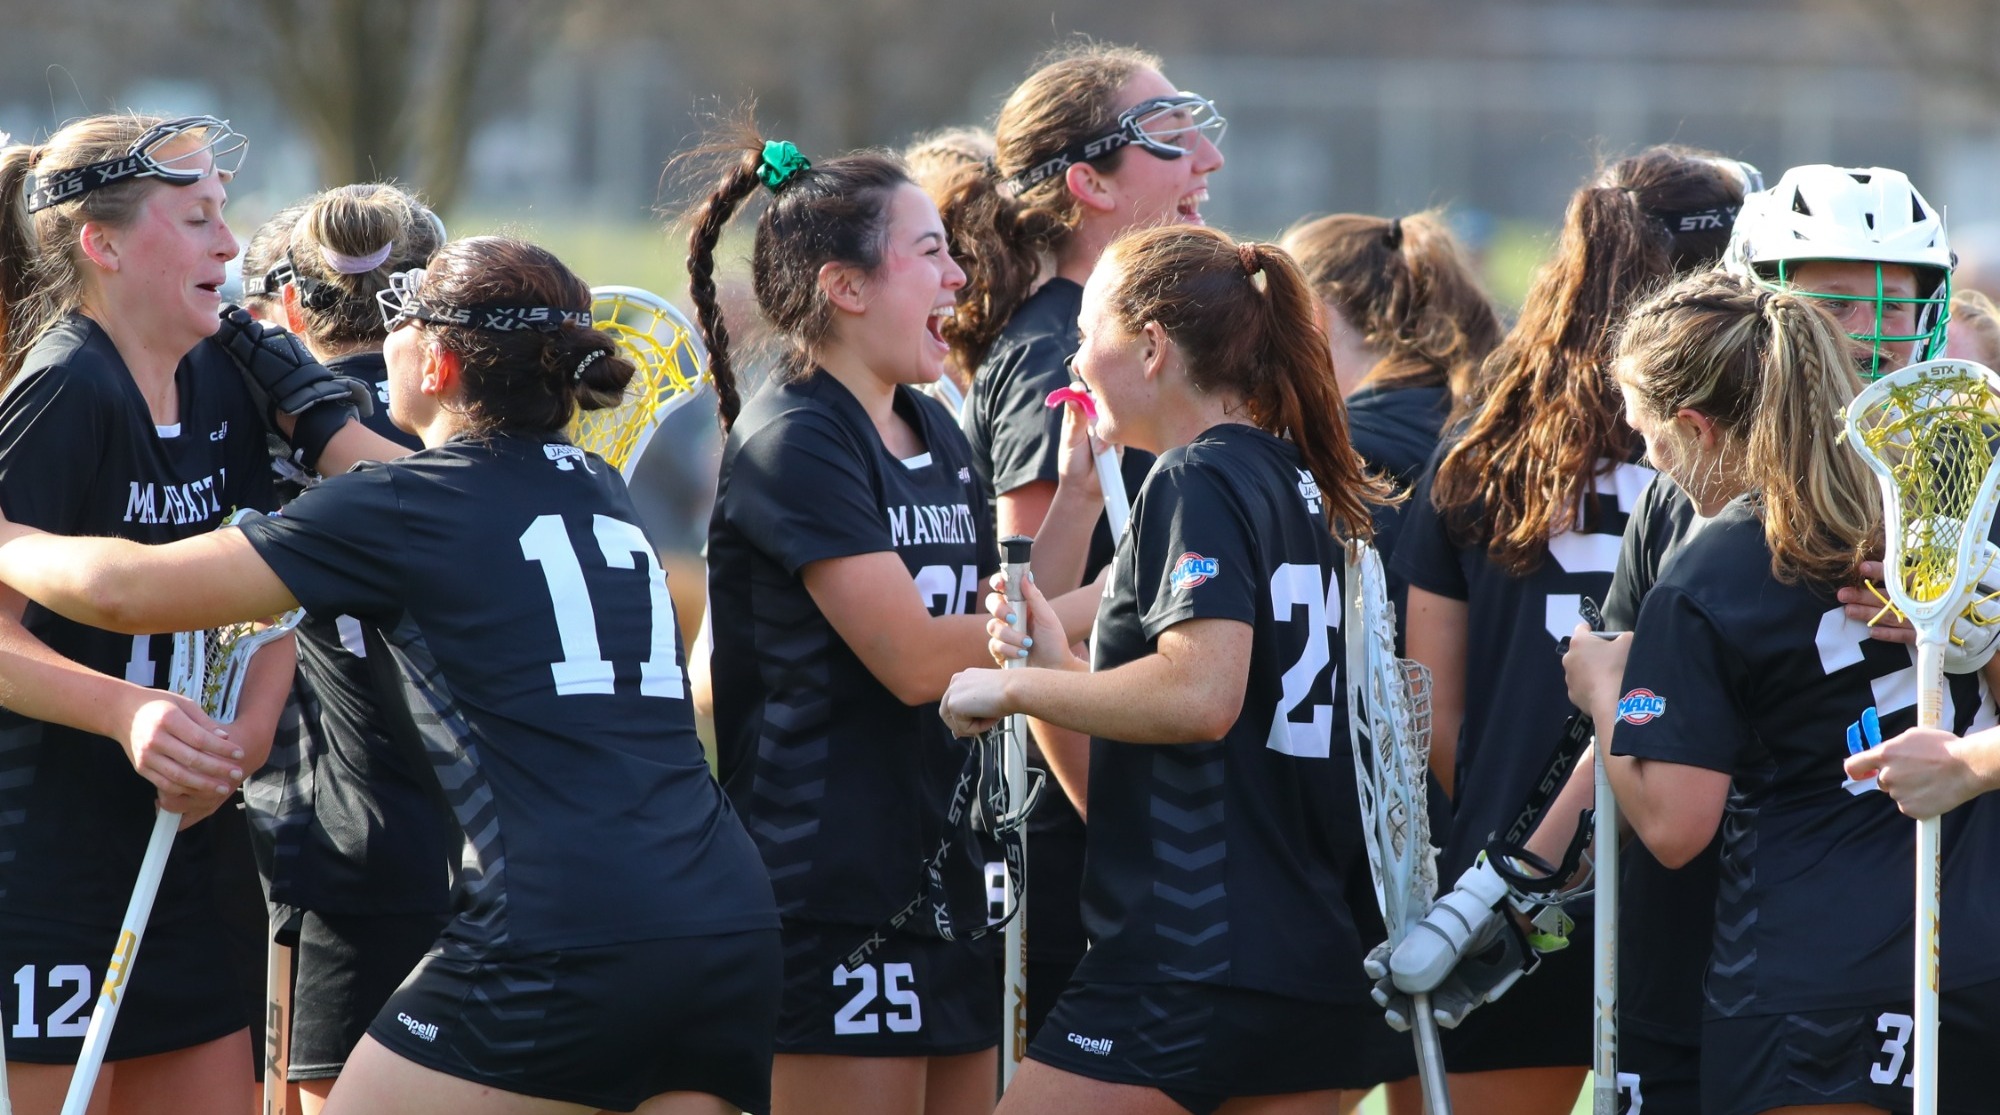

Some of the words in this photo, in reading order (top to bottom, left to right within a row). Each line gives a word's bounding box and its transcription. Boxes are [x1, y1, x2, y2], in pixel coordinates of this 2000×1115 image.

[1085, 131, 1128, 159] STX
[1030, 154, 1071, 183] STX
[43, 177, 84, 204] STX
[1679, 214, 1724, 231] STX
[1931, 365, 1955, 376] STX
[123, 467, 225, 525] MANHATT
[887, 504, 977, 547] MANHATT
[518, 513, 684, 700] 17
[1266, 562, 1341, 758] 2
[1570, 712, 1592, 742] ST
[1617, 696, 1664, 720] MAAC
[1539, 751, 1572, 796] STX
[948, 772, 972, 827] STX
[1505, 803, 1539, 844] STX
[891, 892, 928, 929] STX
[101, 929, 138, 1008] STX
[849, 932, 886, 968] STX
[12, 964, 91, 1039] 12
[833, 962, 921, 1036] 25
[266, 1000, 284, 1080] STX
[397, 1011, 439, 1040] capelli
[411, 1028, 435, 1043] SPORT
[1013, 983, 1027, 1063] STX
[1067, 1032, 1114, 1053] capelli
[1597, 995, 1617, 1080] STX
[1084, 1046, 1110, 1057] SPORT
[1869, 1012, 1914, 1088] 3
